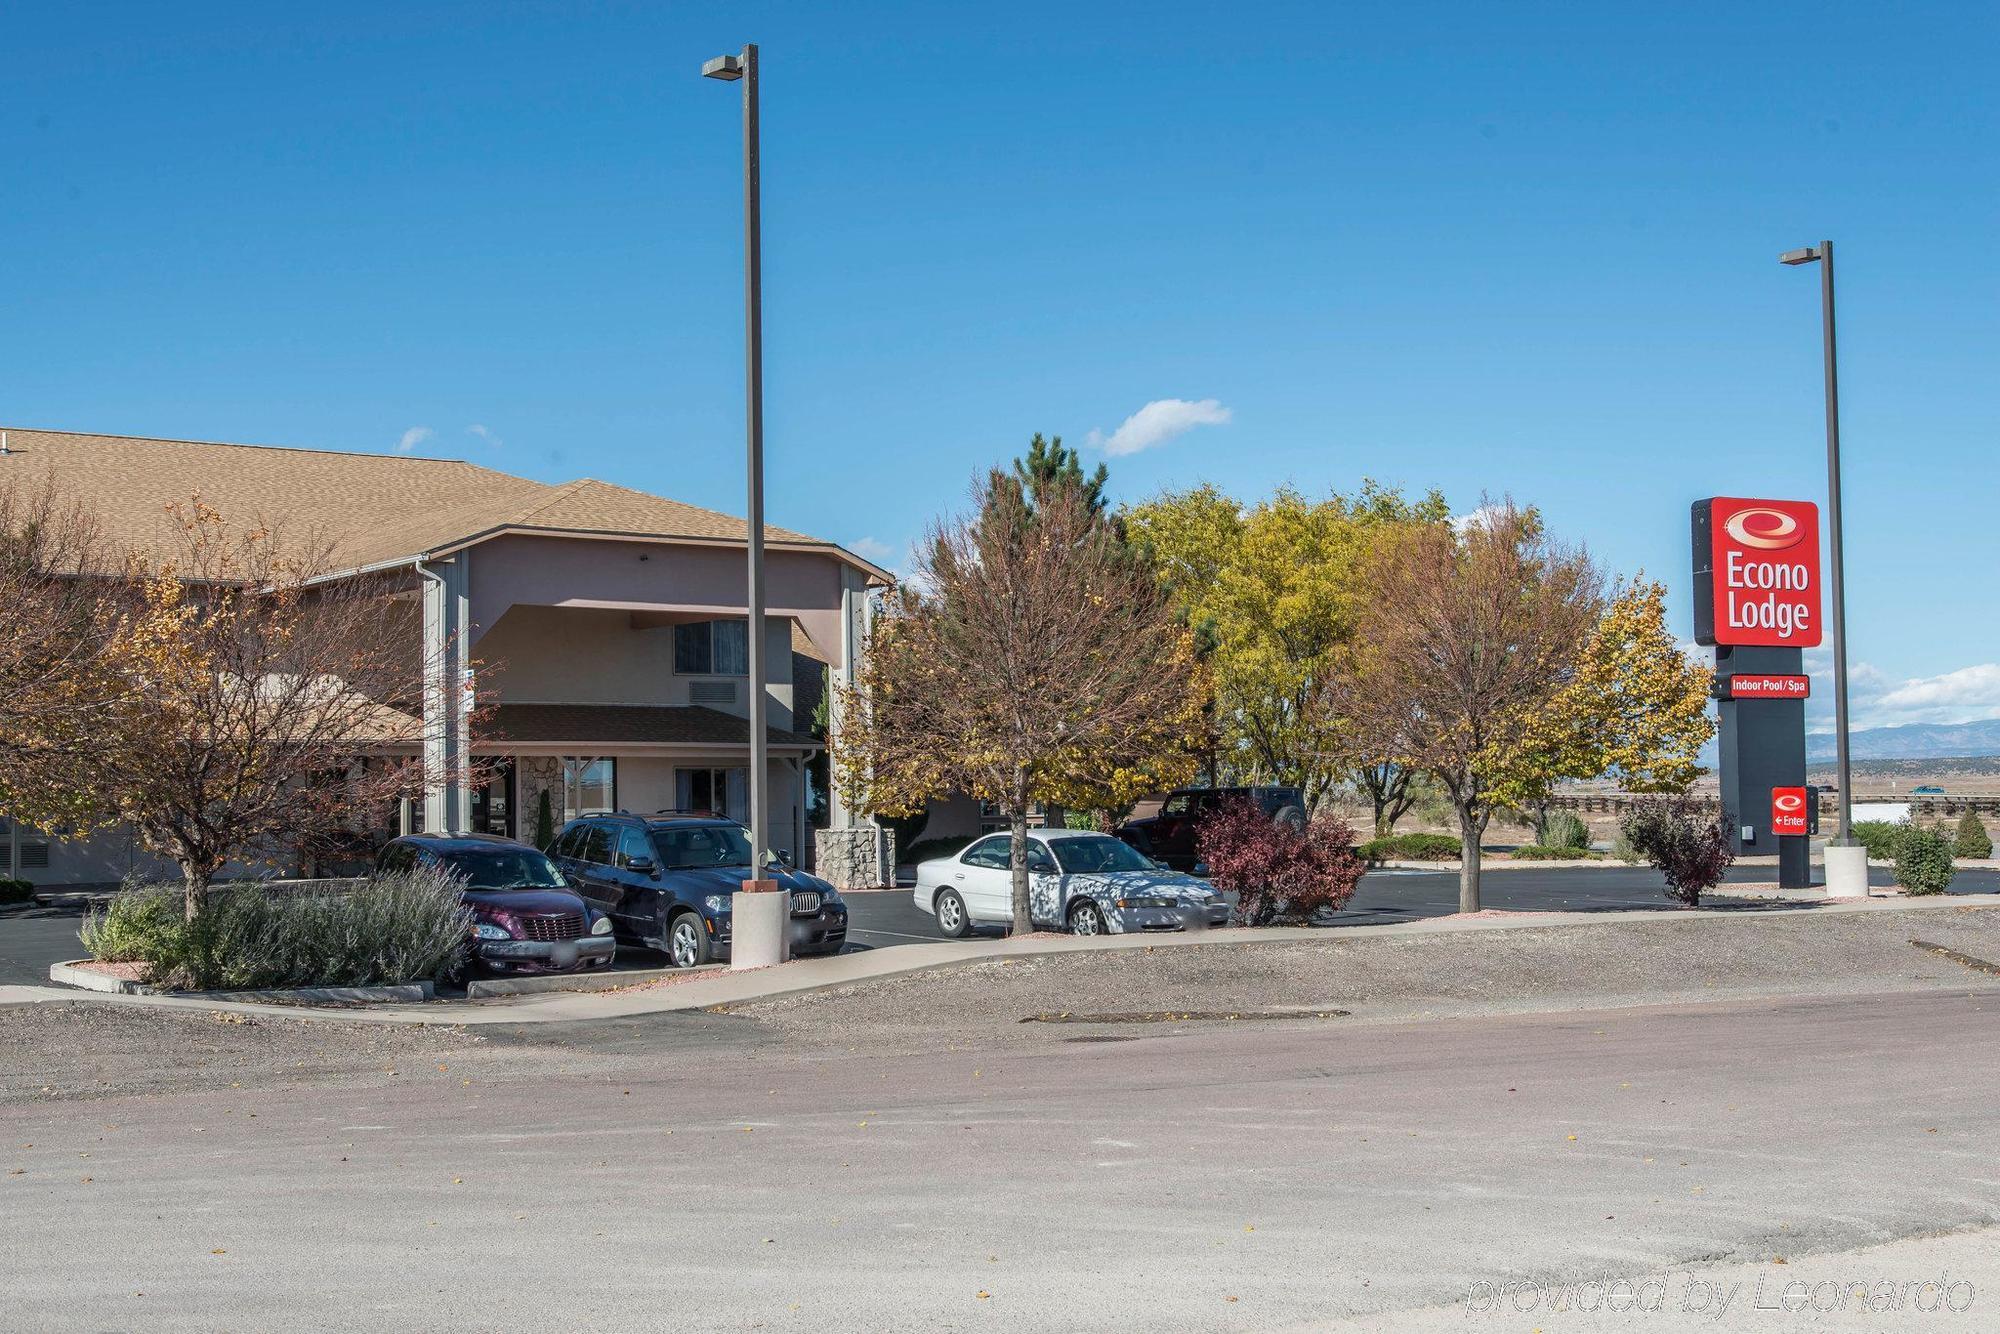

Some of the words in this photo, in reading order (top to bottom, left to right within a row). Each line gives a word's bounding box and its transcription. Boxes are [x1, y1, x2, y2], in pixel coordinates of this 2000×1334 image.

[1727, 551, 1808, 591] Econo
[1728, 591, 1809, 638] Lodge
[1732, 679, 1761, 691] Indoor
[1763, 679, 1805, 693] Pool/Spa
[1783, 815, 1805, 826] Enter
